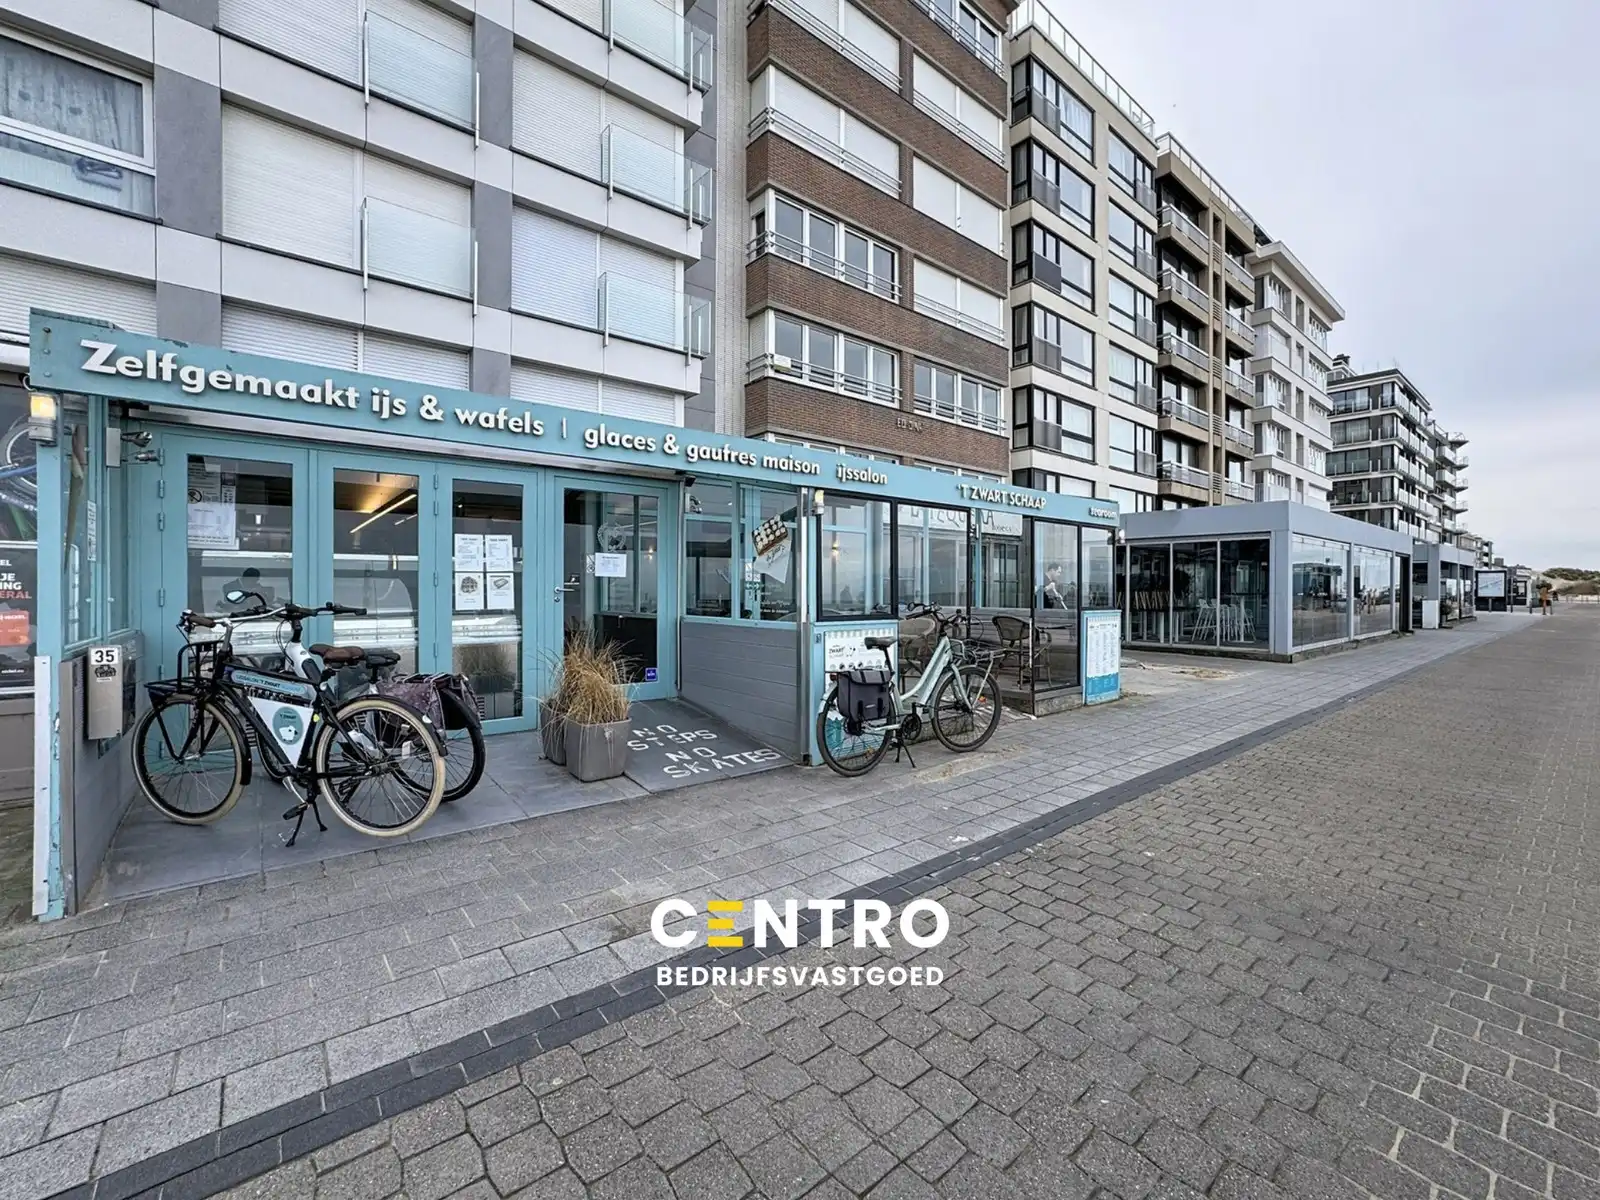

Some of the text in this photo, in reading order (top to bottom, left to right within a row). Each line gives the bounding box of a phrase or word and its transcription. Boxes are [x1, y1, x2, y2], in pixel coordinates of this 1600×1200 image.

[80, 339, 545, 436] Zelfgemaakt ijs & wafels
[584, 423, 820, 475] glaces & gaufres maison
[836, 463, 888, 485] ijssalon
[971, 487, 1009, 505] ZWART
[1009, 493, 1047, 510] SCHAAP
[95, 650, 115, 663] 35
[627, 729, 718, 751] STEPS
[632, 724, 677, 737] NO
[663, 748, 782, 778] SKATES
[665, 747, 717, 762] NO
